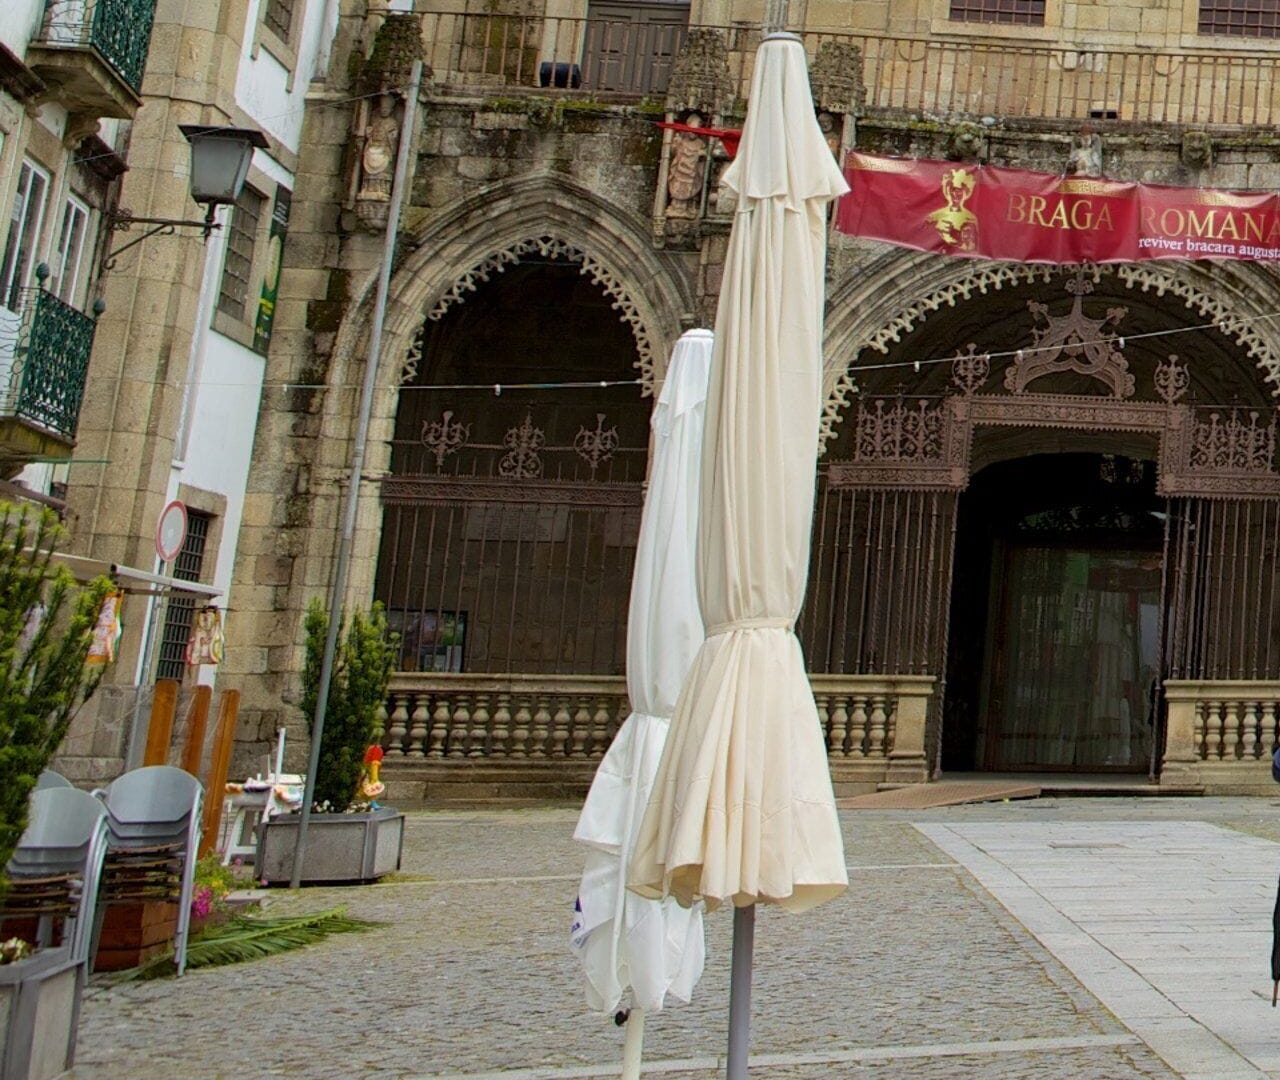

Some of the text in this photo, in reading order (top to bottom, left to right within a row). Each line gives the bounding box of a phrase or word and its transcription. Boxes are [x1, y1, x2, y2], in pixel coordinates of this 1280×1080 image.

[1006, 193, 1115, 232] BRAGA
[1138, 235, 1183, 250] reviver
[1186, 239, 1236, 255] bracara
